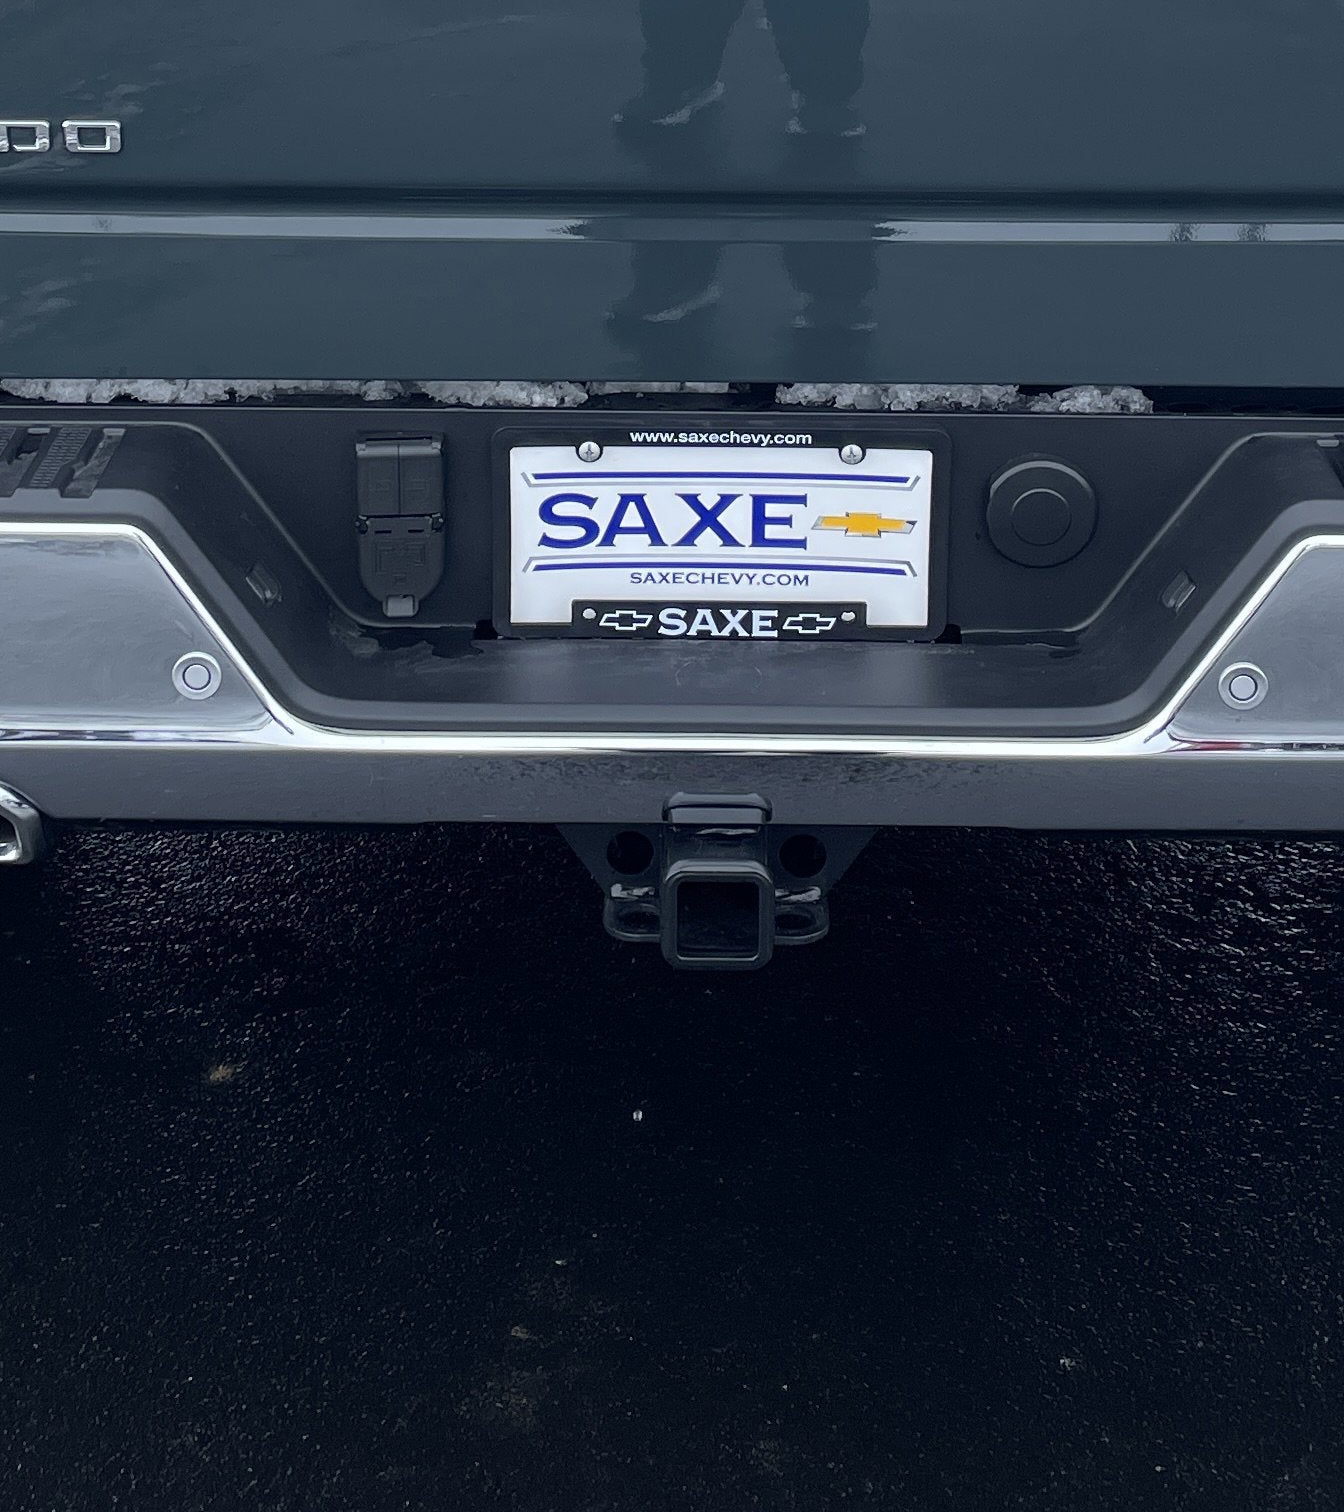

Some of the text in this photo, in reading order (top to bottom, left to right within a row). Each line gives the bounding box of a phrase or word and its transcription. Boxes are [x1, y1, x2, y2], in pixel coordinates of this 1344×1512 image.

[629, 429, 813, 447] www.saxechevy.com
[537, 492, 809, 551] SAXE
[629, 571, 810, 587] SAXECHEVY.COM
[657, 607, 779, 638] SAXE
